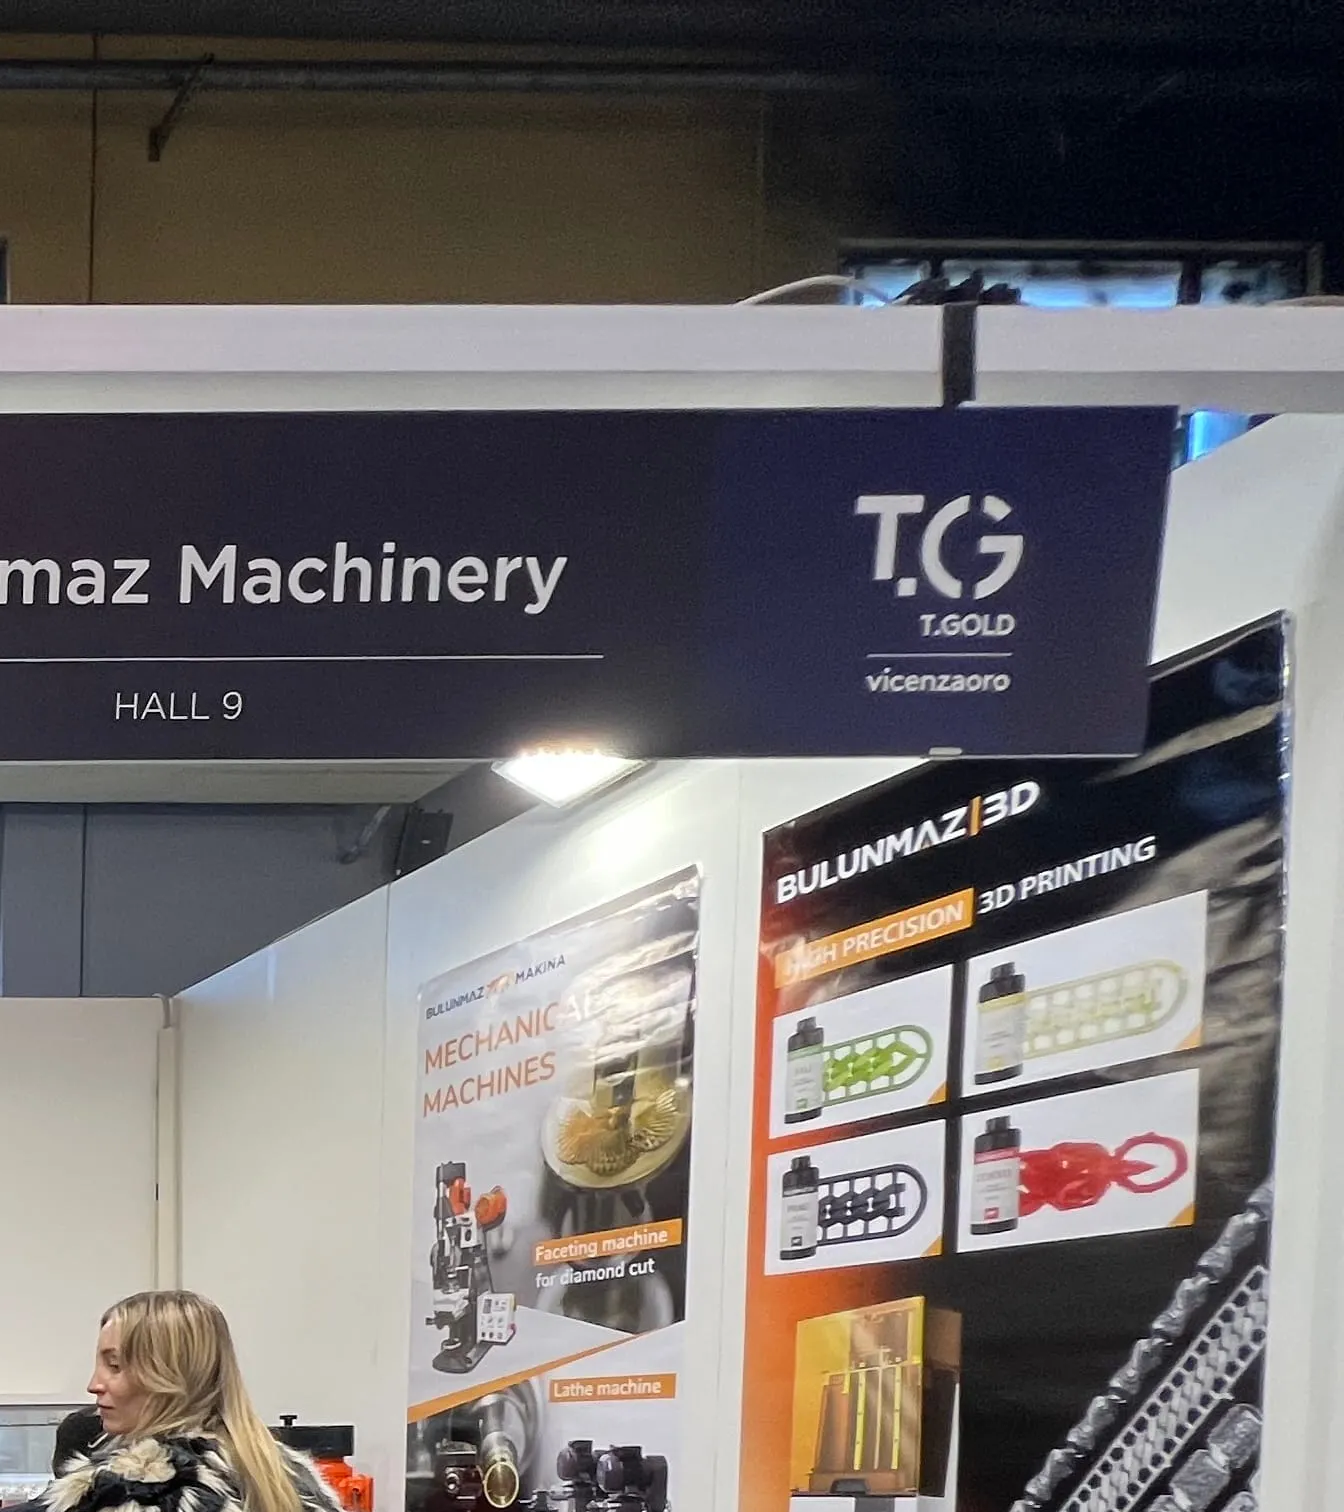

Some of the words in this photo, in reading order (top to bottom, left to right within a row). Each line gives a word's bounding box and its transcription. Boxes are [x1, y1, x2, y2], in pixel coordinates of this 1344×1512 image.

[179, 542, 567, 615] Machinery
[919, 614, 1015, 638] T.GOLD
[865, 668, 1010, 693] vicenzaoro
[115, 692, 210, 721] HALL
[222, 692, 243, 721] 9
[843, 899, 965, 958] PRECISION
[977, 881, 1015, 914] 3D
[1020, 835, 1156, 902] PRINTING
[426, 986, 485, 1019] BULUNMAZ
[515, 954, 566, 985] MAKINA
[423, 1051, 556, 1118] MACHINES
[534, 1240, 599, 1262] Faceting
[602, 1229, 668, 1249] machine
[534, 1272, 557, 1288] for
[559, 1262, 626, 1285] diamond
[628, 1258, 656, 1276] cut
[553, 1381, 593, 1397] Lathe
[596, 1379, 662, 1396] machine
